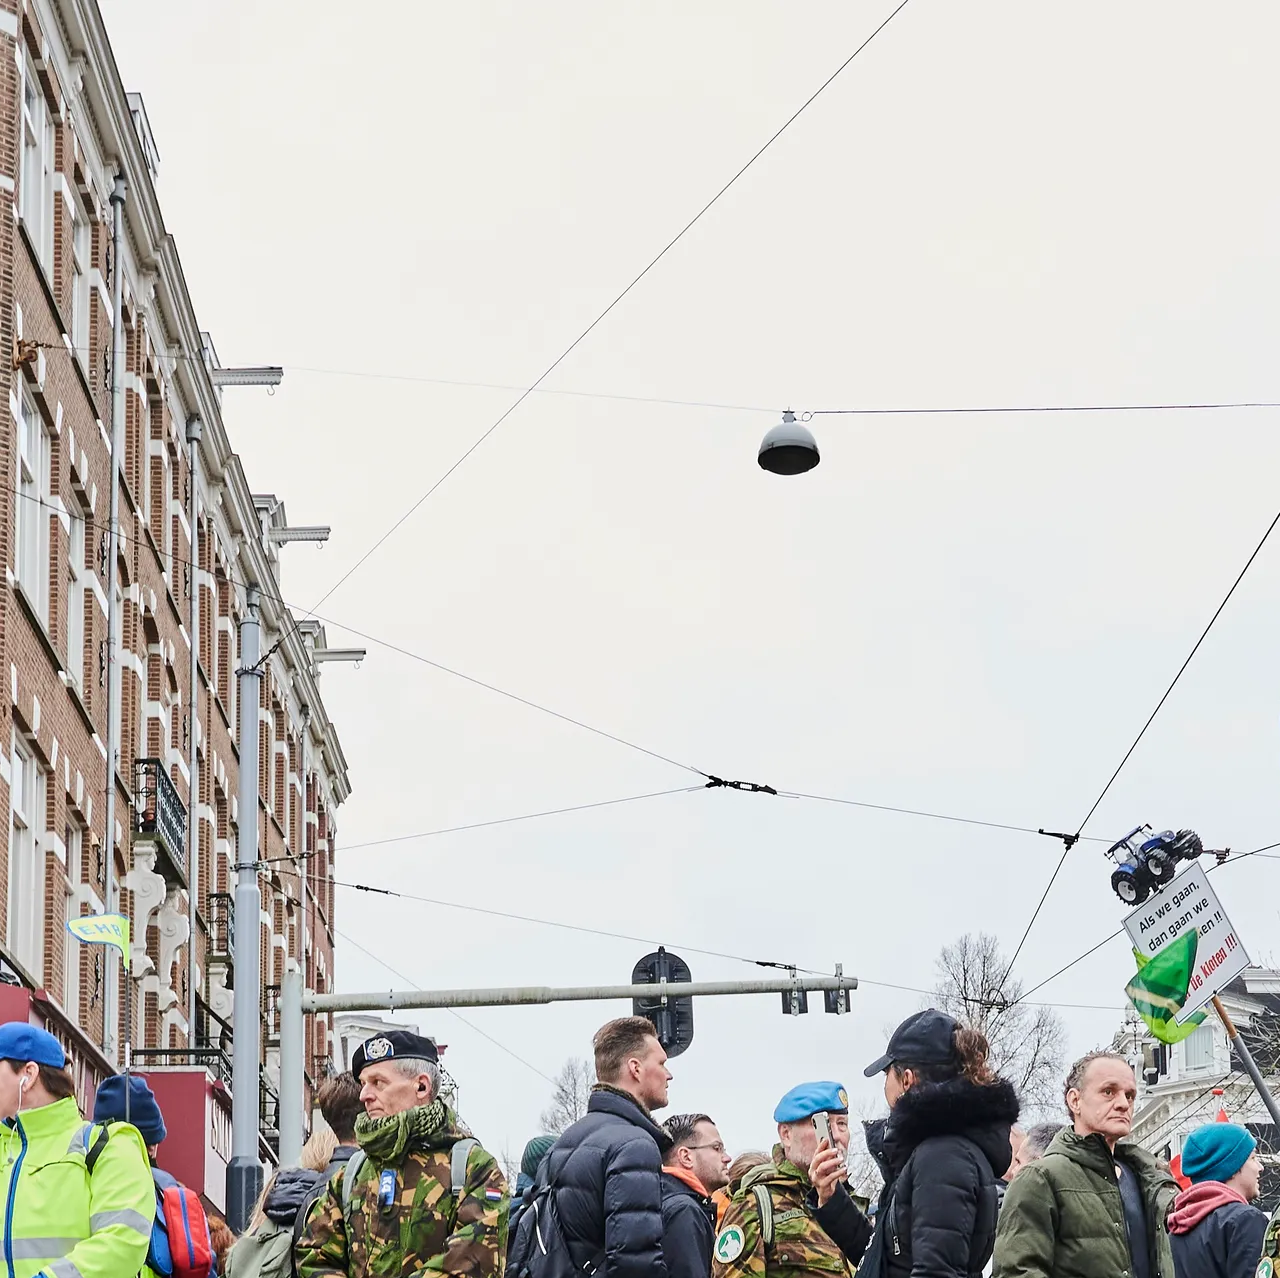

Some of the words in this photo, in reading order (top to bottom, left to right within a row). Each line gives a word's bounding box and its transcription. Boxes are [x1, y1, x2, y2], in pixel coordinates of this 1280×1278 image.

[1139, 915, 1156, 934] Als
[1155, 902, 1172, 919] we
[1172, 882, 1200, 908] gaan,
[1148, 931, 1169, 952] dan
[1168, 911, 1193, 937] gaan
[1192, 897, 1209, 914] we
[1199, 919, 1215, 939] en
[1200, 947, 1228, 979] kloten
